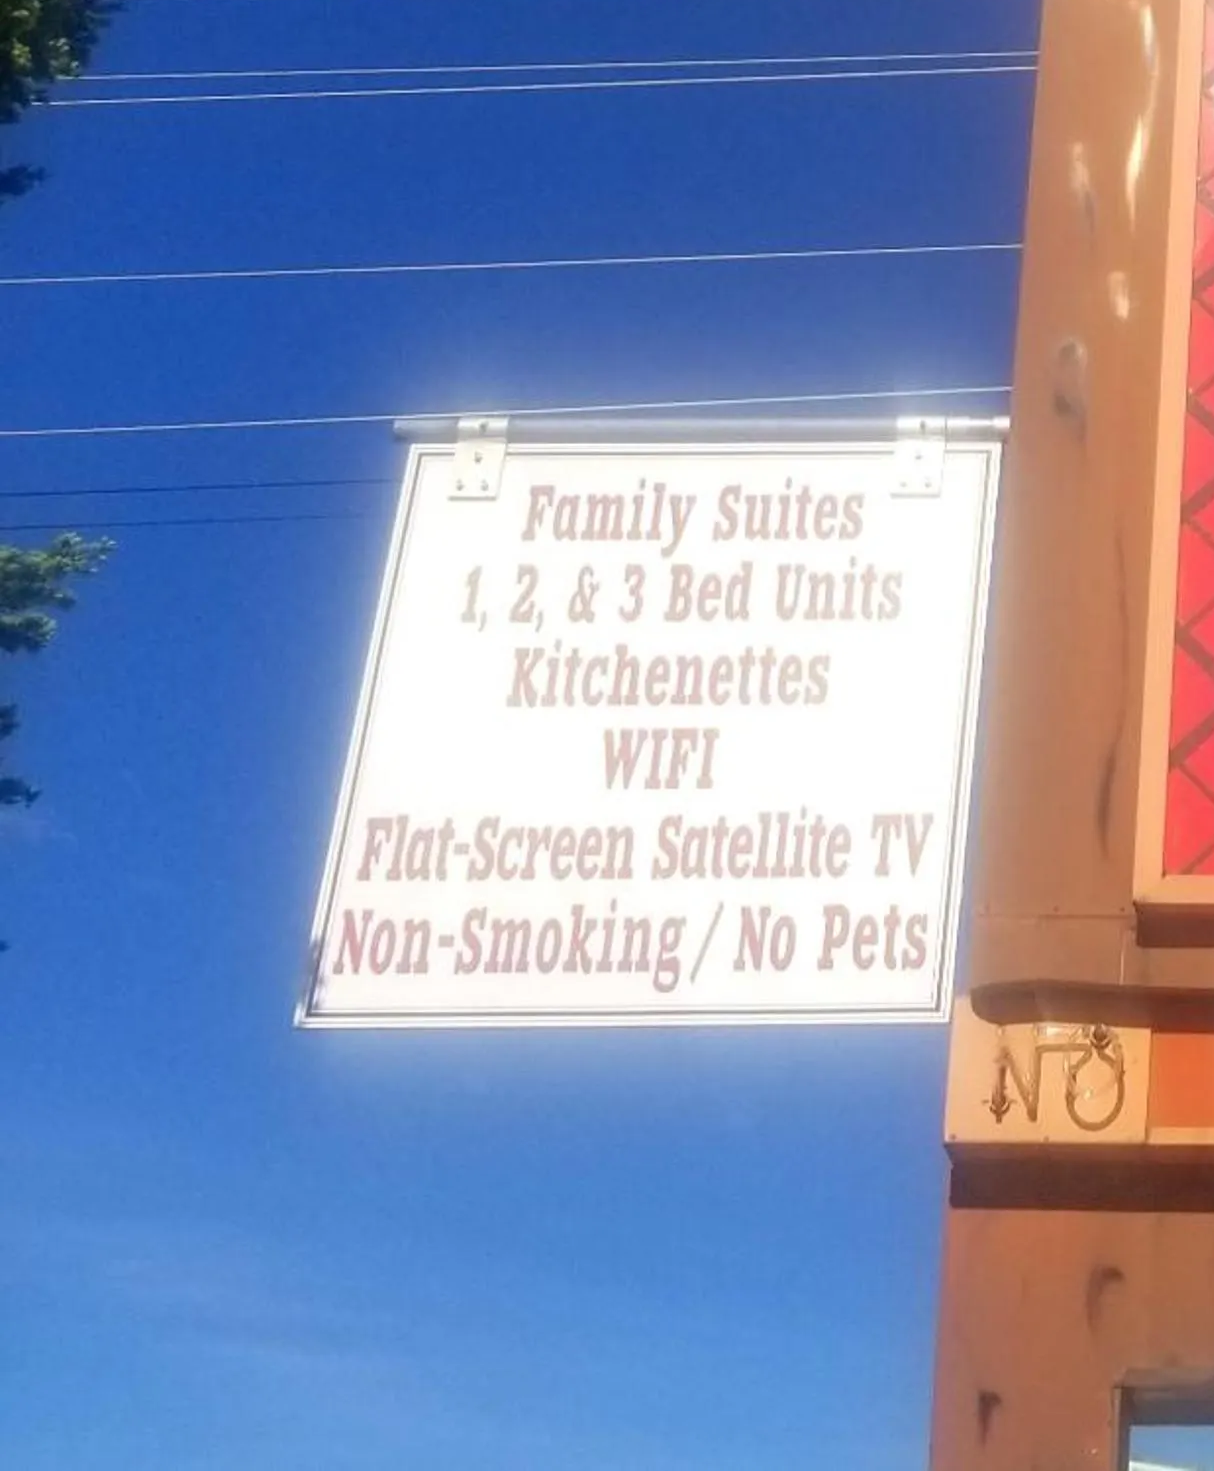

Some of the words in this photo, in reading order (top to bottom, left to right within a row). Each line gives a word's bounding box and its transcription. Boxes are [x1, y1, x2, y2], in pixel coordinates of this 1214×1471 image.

[521, 478, 695, 558] Family
[711, 478, 865, 542] Suites
[460, 564, 489, 632] 1,
[510, 564, 545, 632] 2,
[567, 565, 600, 623] &
[619, 563, 645, 623] 3
[664, 559, 753, 622] Bed
[775, 557, 902, 621] Units
[506, 640, 831, 707] Kitchenettes
[603, 729, 719, 790] WIFI
[357, 814, 635, 882] Flat-Screen
[651, 806, 851, 880] Satellite
[871, 813, 934, 878] TV
[817, 904, 929, 971] Pets
[985, 1022, 1125, 1132] NO
